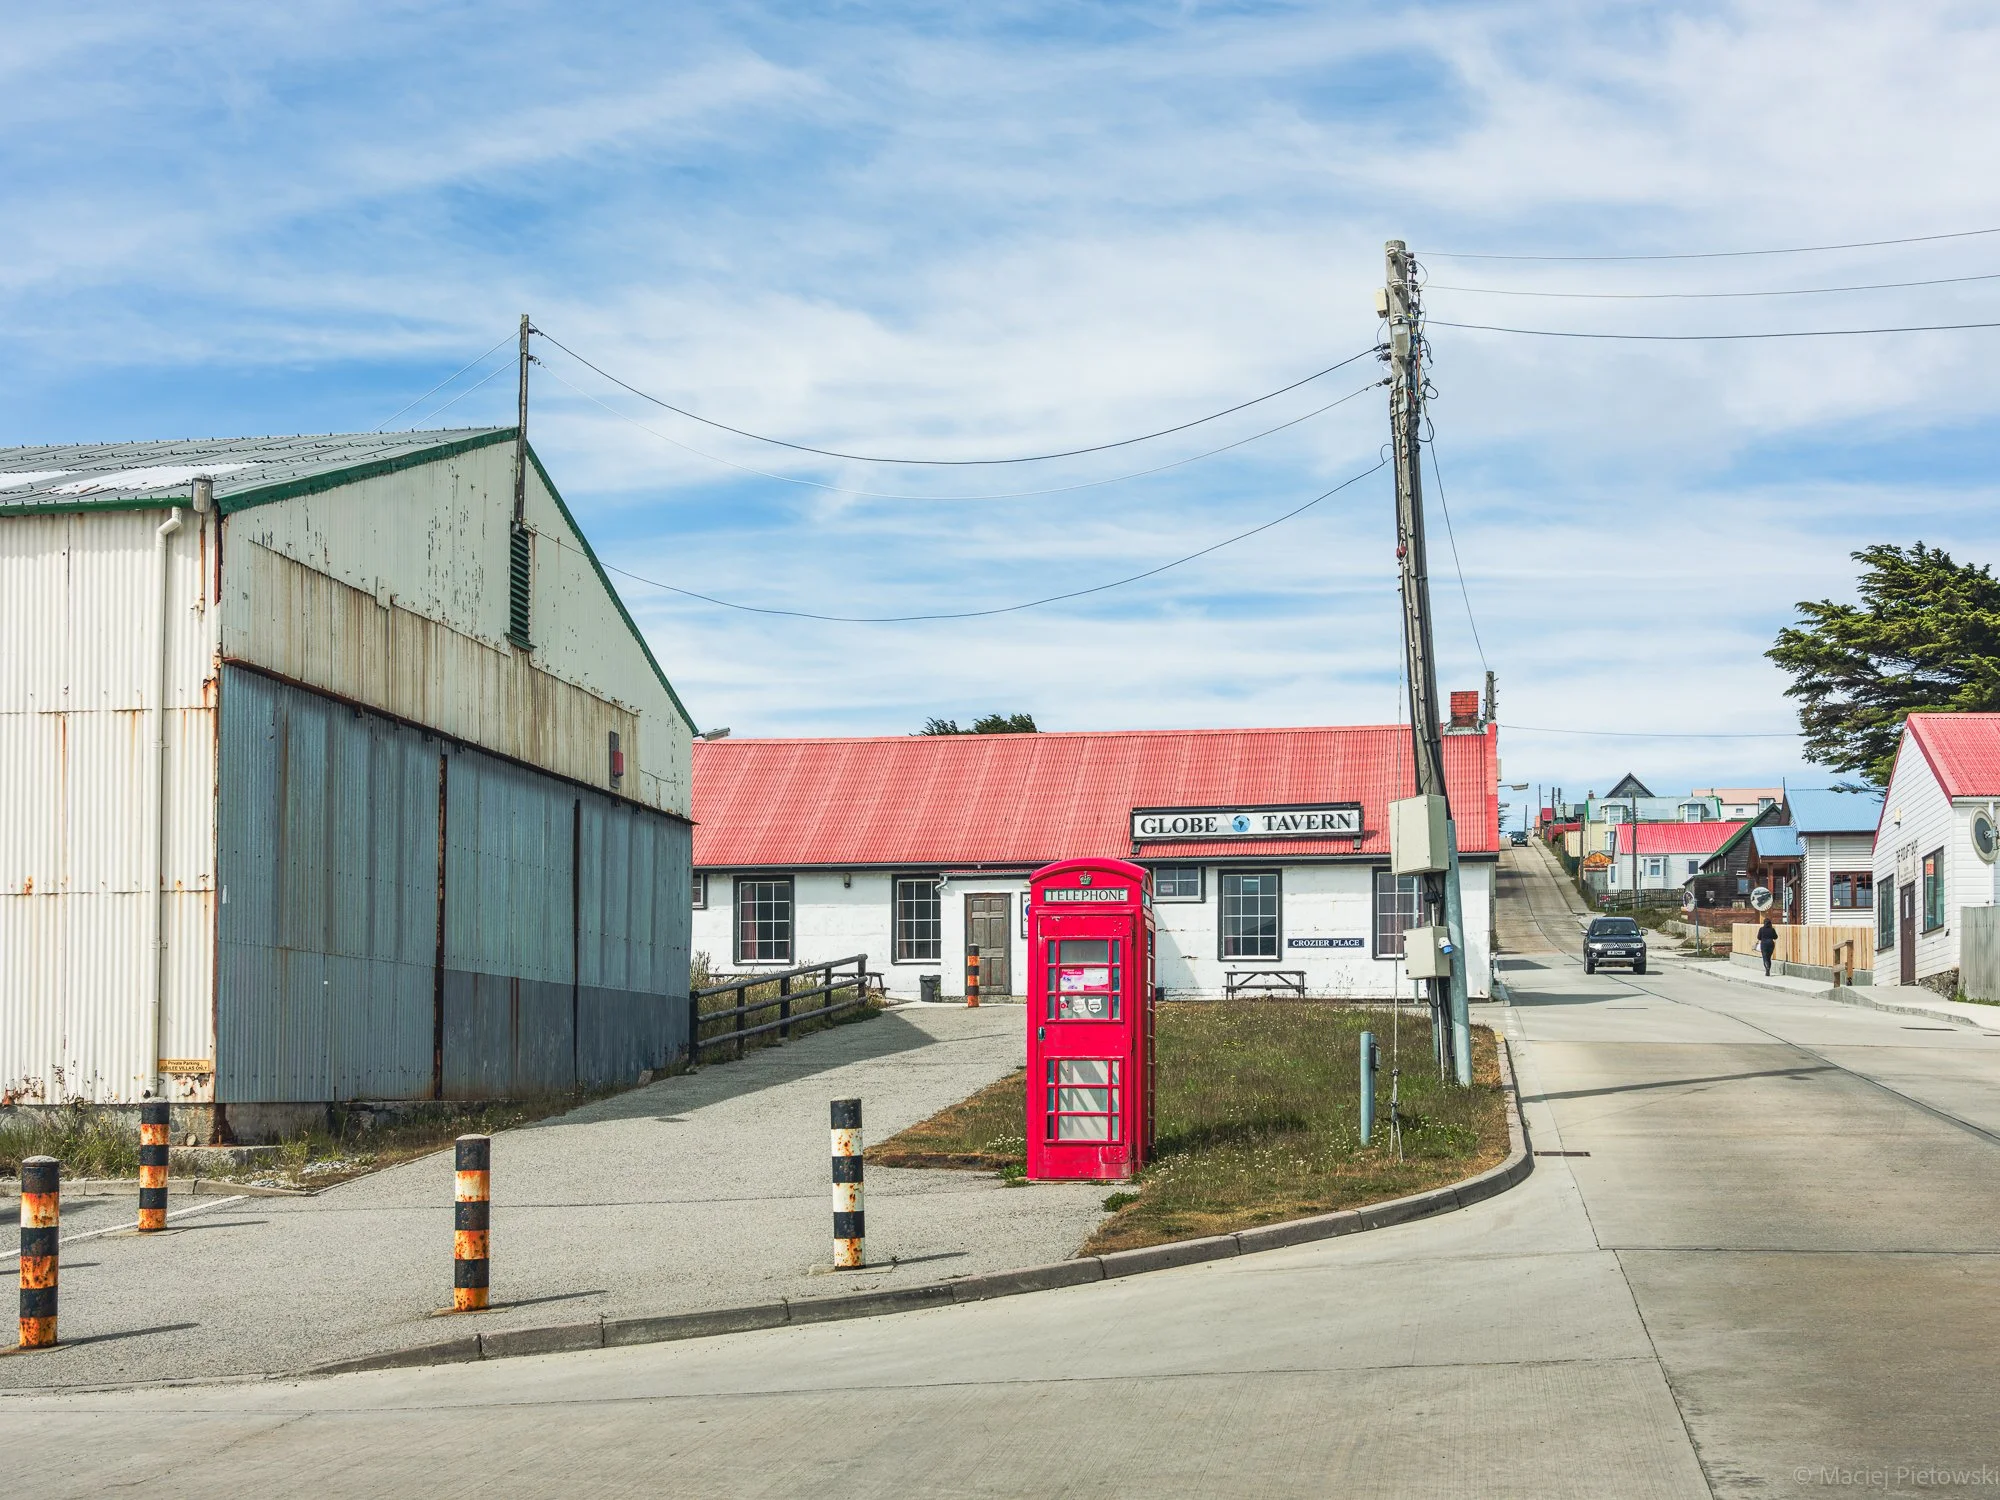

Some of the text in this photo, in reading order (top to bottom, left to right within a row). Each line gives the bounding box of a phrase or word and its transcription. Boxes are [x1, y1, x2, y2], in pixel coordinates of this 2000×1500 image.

[1140, 813, 1352, 834] GLOBE TAVERN
[1049, 889, 1125, 901] TELEPHONE
